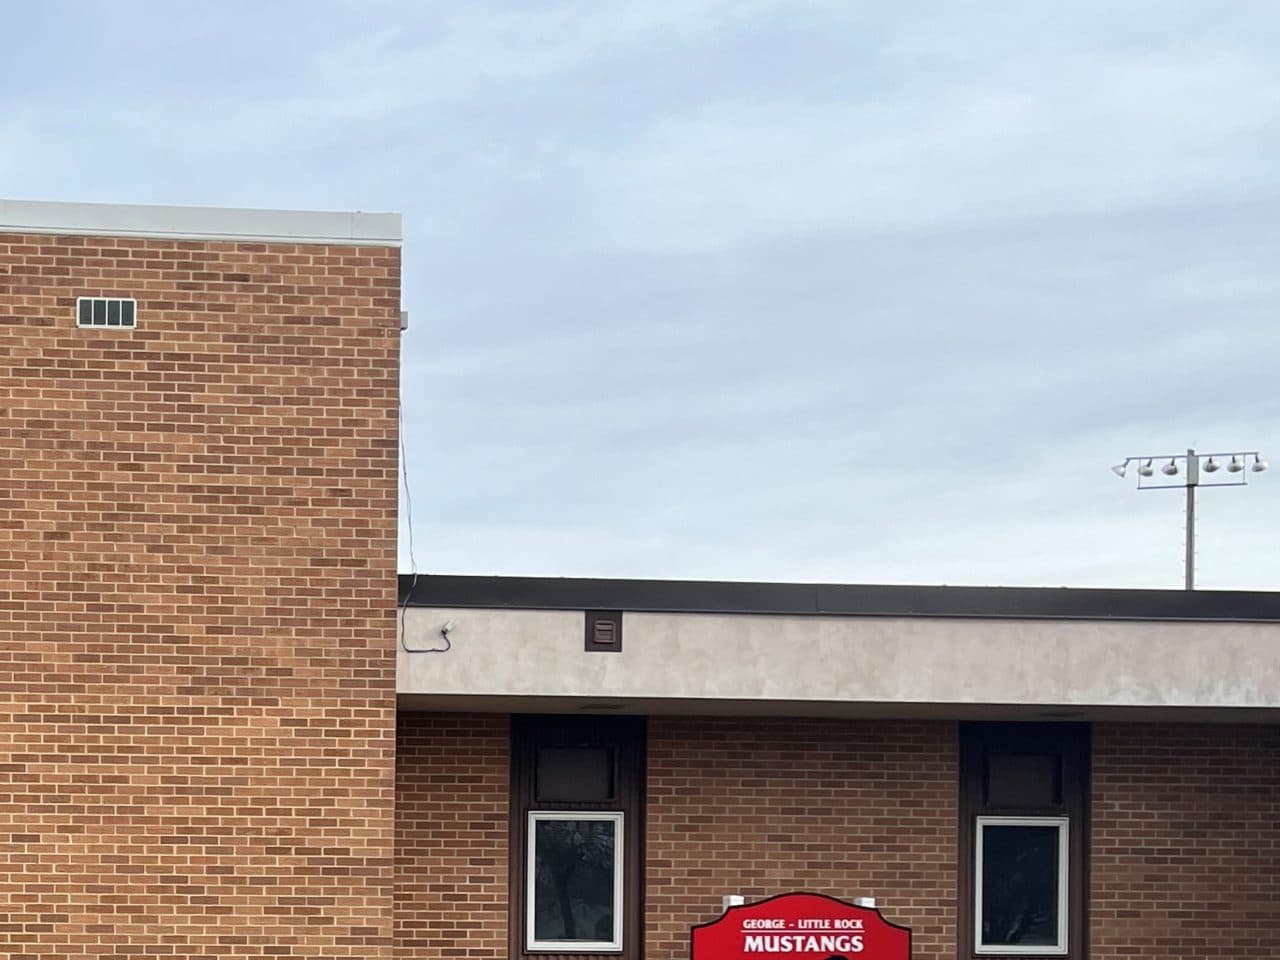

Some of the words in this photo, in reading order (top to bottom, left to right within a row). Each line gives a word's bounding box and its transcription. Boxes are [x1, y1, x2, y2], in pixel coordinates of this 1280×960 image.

[743, 919, 785, 929] GEORGE
[798, 919, 831, 929] LITTLE
[834, 919, 863, 929] ROCK
[743, 935, 864, 952] MUSTANGS
